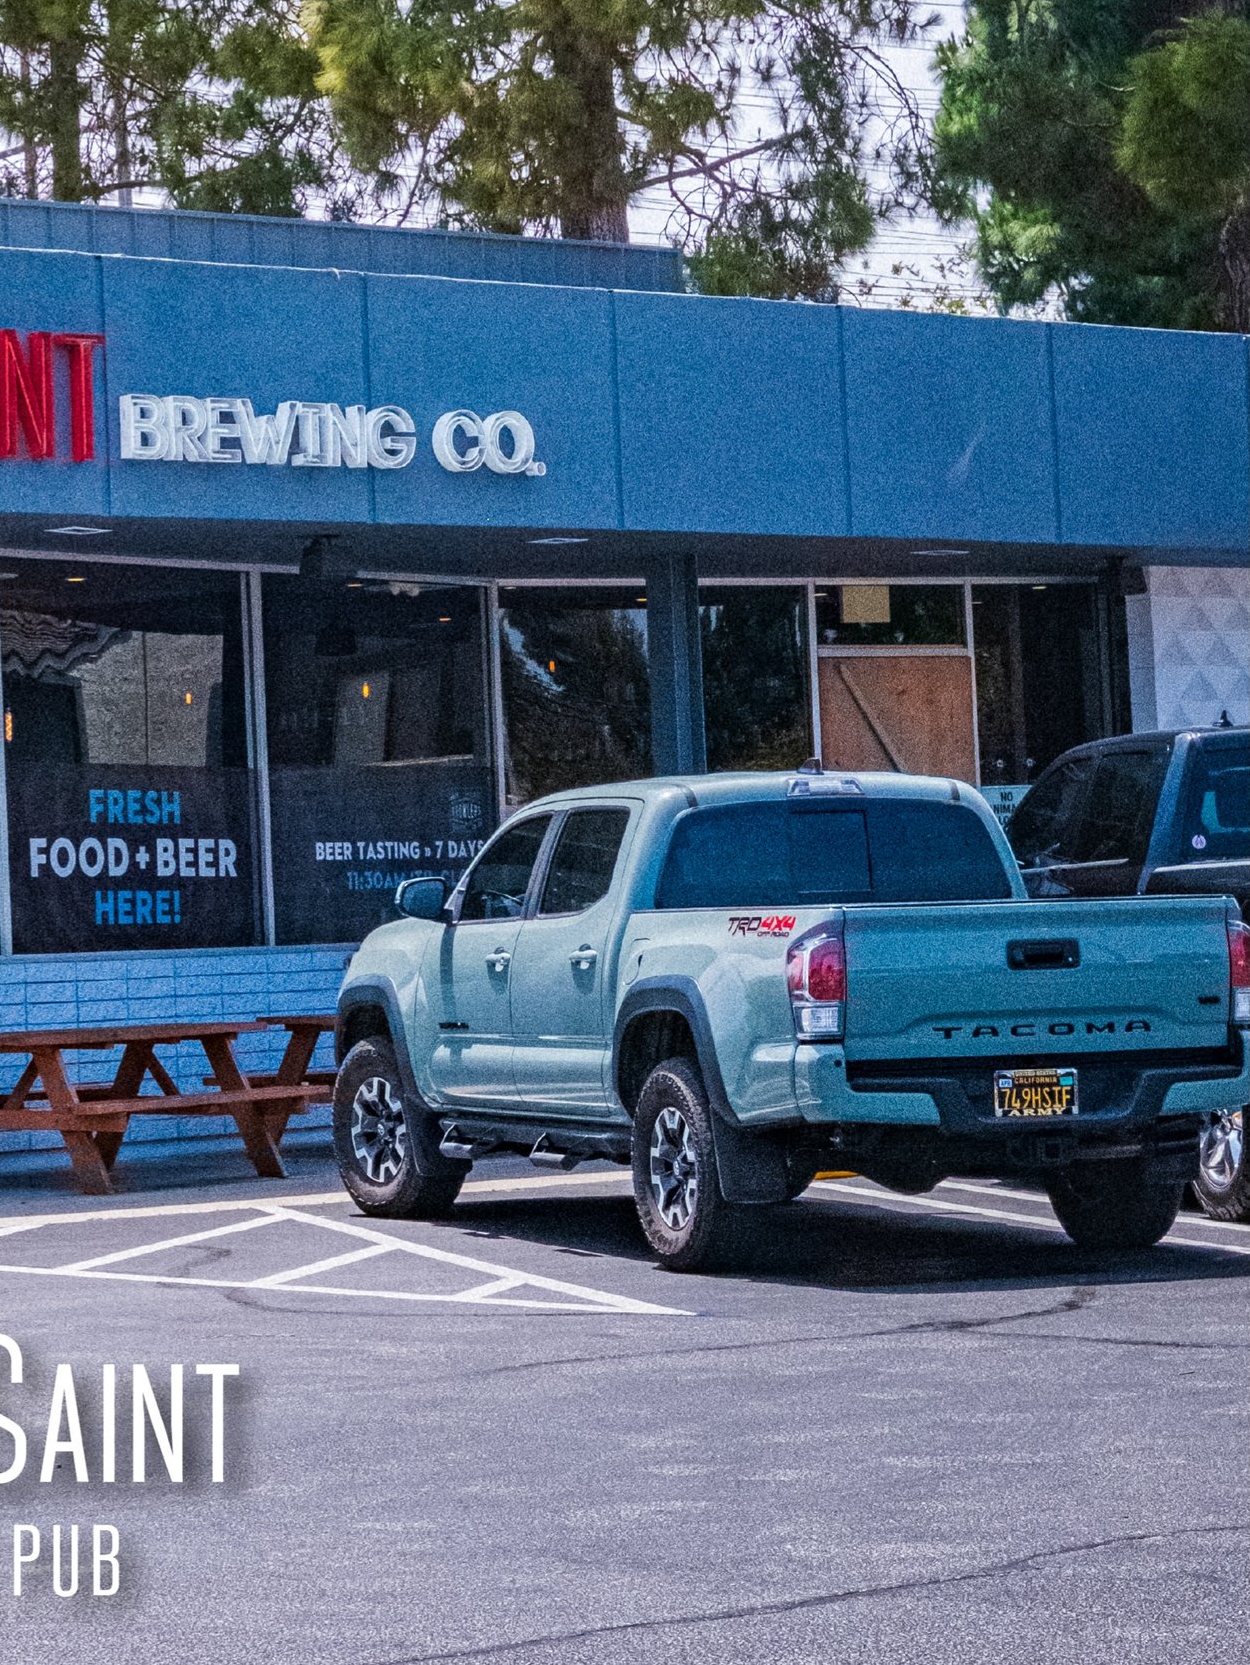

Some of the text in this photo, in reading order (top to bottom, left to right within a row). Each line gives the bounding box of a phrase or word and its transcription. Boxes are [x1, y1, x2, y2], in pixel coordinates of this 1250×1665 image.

[119, 393, 417, 469] BREWING
[432, 408, 547, 477] CO.
[88, 789, 181, 824] FRESH
[1000, 791, 1013, 802] NO
[315, 841, 352, 860] BEER
[357, 841, 420, 860] TASTING
[435, 840, 444, 859] 7
[95, 890, 181, 924] HERE!
[932, 1019, 1152, 1039] TACOMA
[1014, 1076, 1057, 1084] CALIFORNIA
[1008, 1107, 1066, 1116] ARMY
